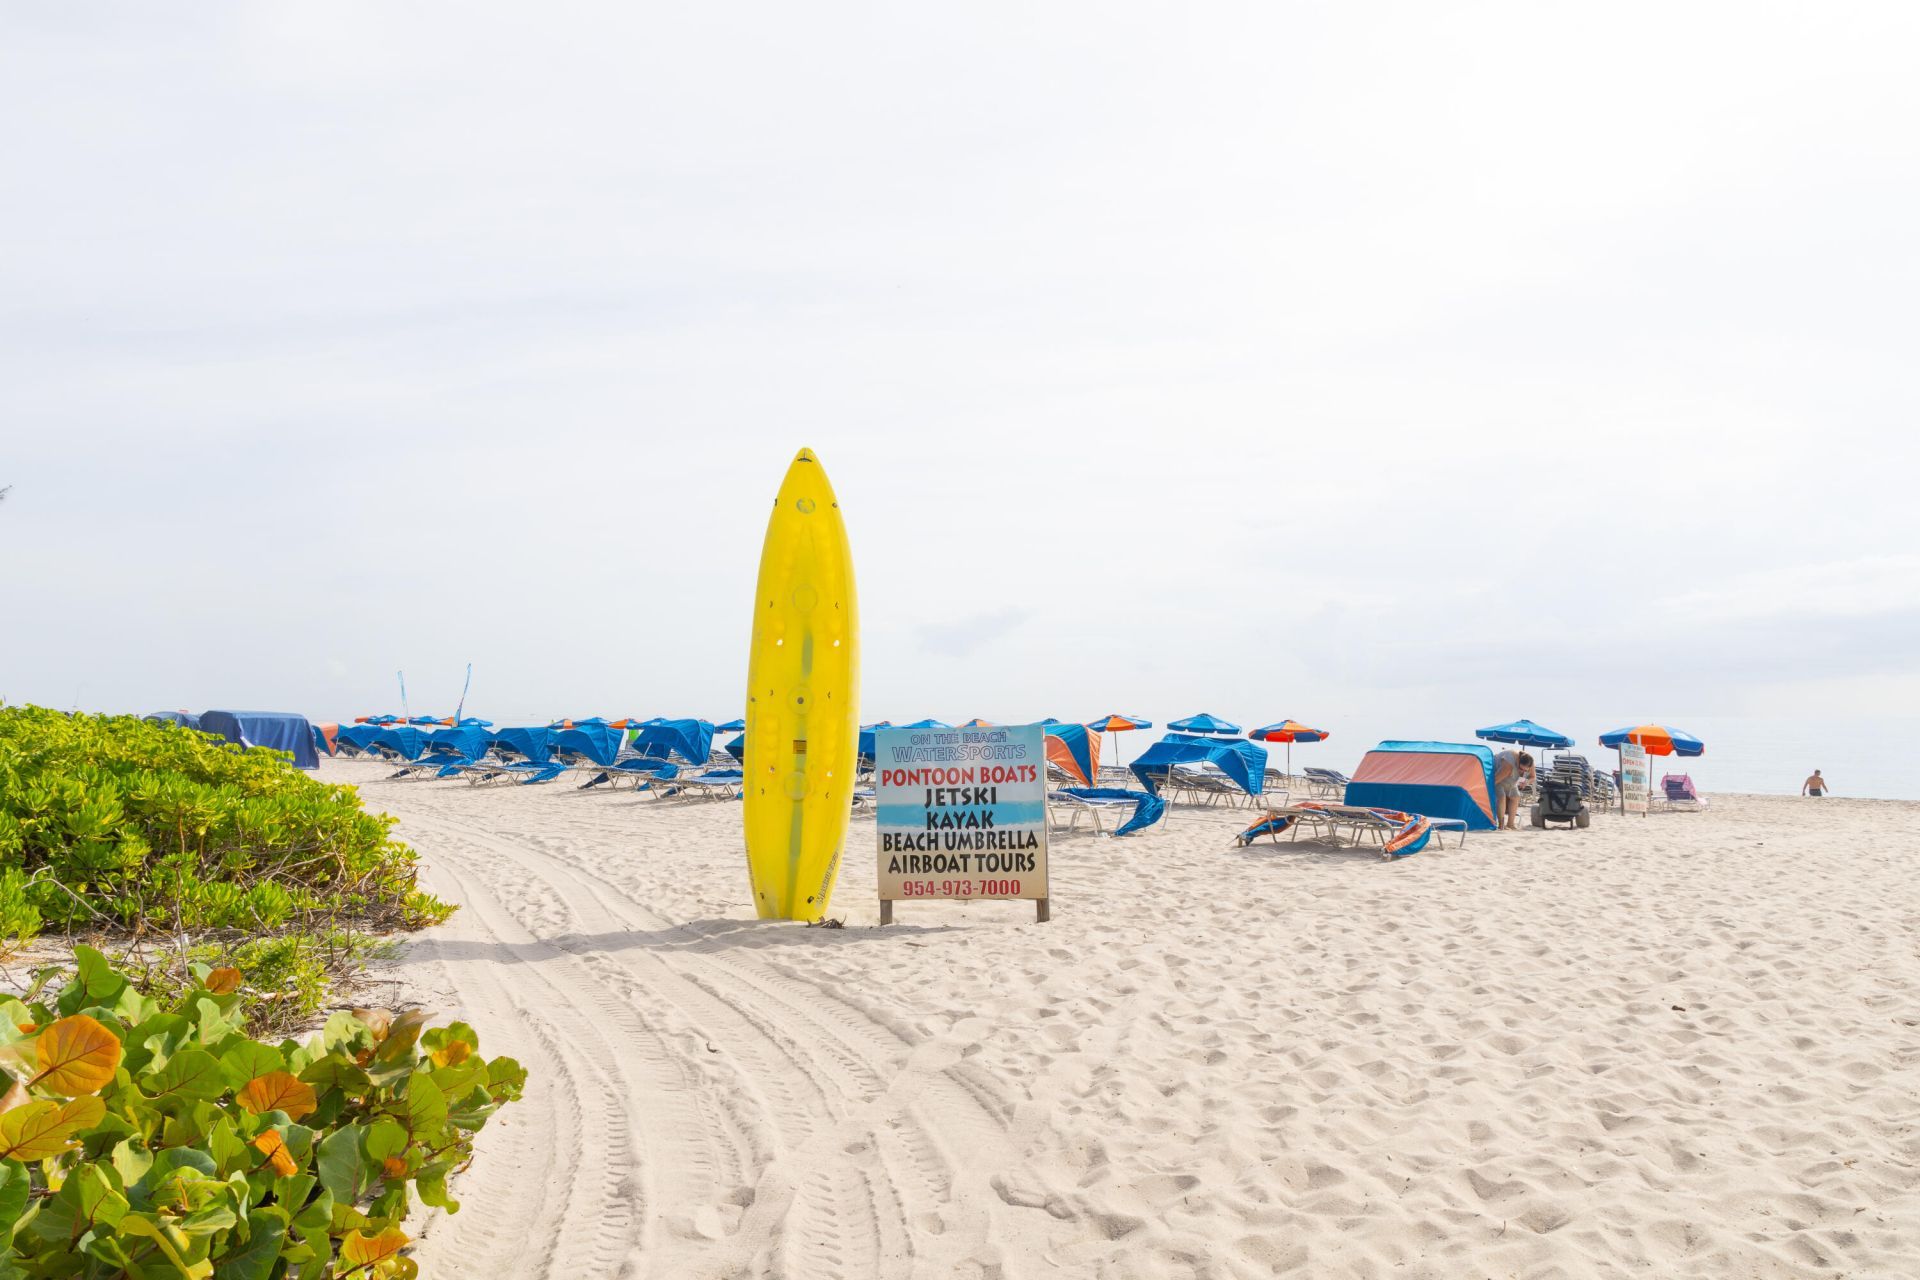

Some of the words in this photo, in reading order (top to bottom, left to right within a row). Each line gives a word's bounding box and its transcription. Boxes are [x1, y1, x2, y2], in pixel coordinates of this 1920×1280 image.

[911, 734, 930, 745] ON
[934, 733, 959, 744] THE
[962, 732, 1006, 743] BEACH
[892, 744, 1026, 762] WATERSPORTS
[882, 767, 974, 786] PONTOON
[980, 765, 1036, 784] BOATS
[924, 787, 996, 808] JETSKI
[926, 810, 994, 830] KAYAK
[883, 832, 939, 852] BEACH
[944, 830, 1038, 851] UMBRELLA
[888, 853, 971, 874] AIRBOAT
[974, 852, 1035, 872] TOURS
[903, 879, 1021, 896] 954-973-7000
